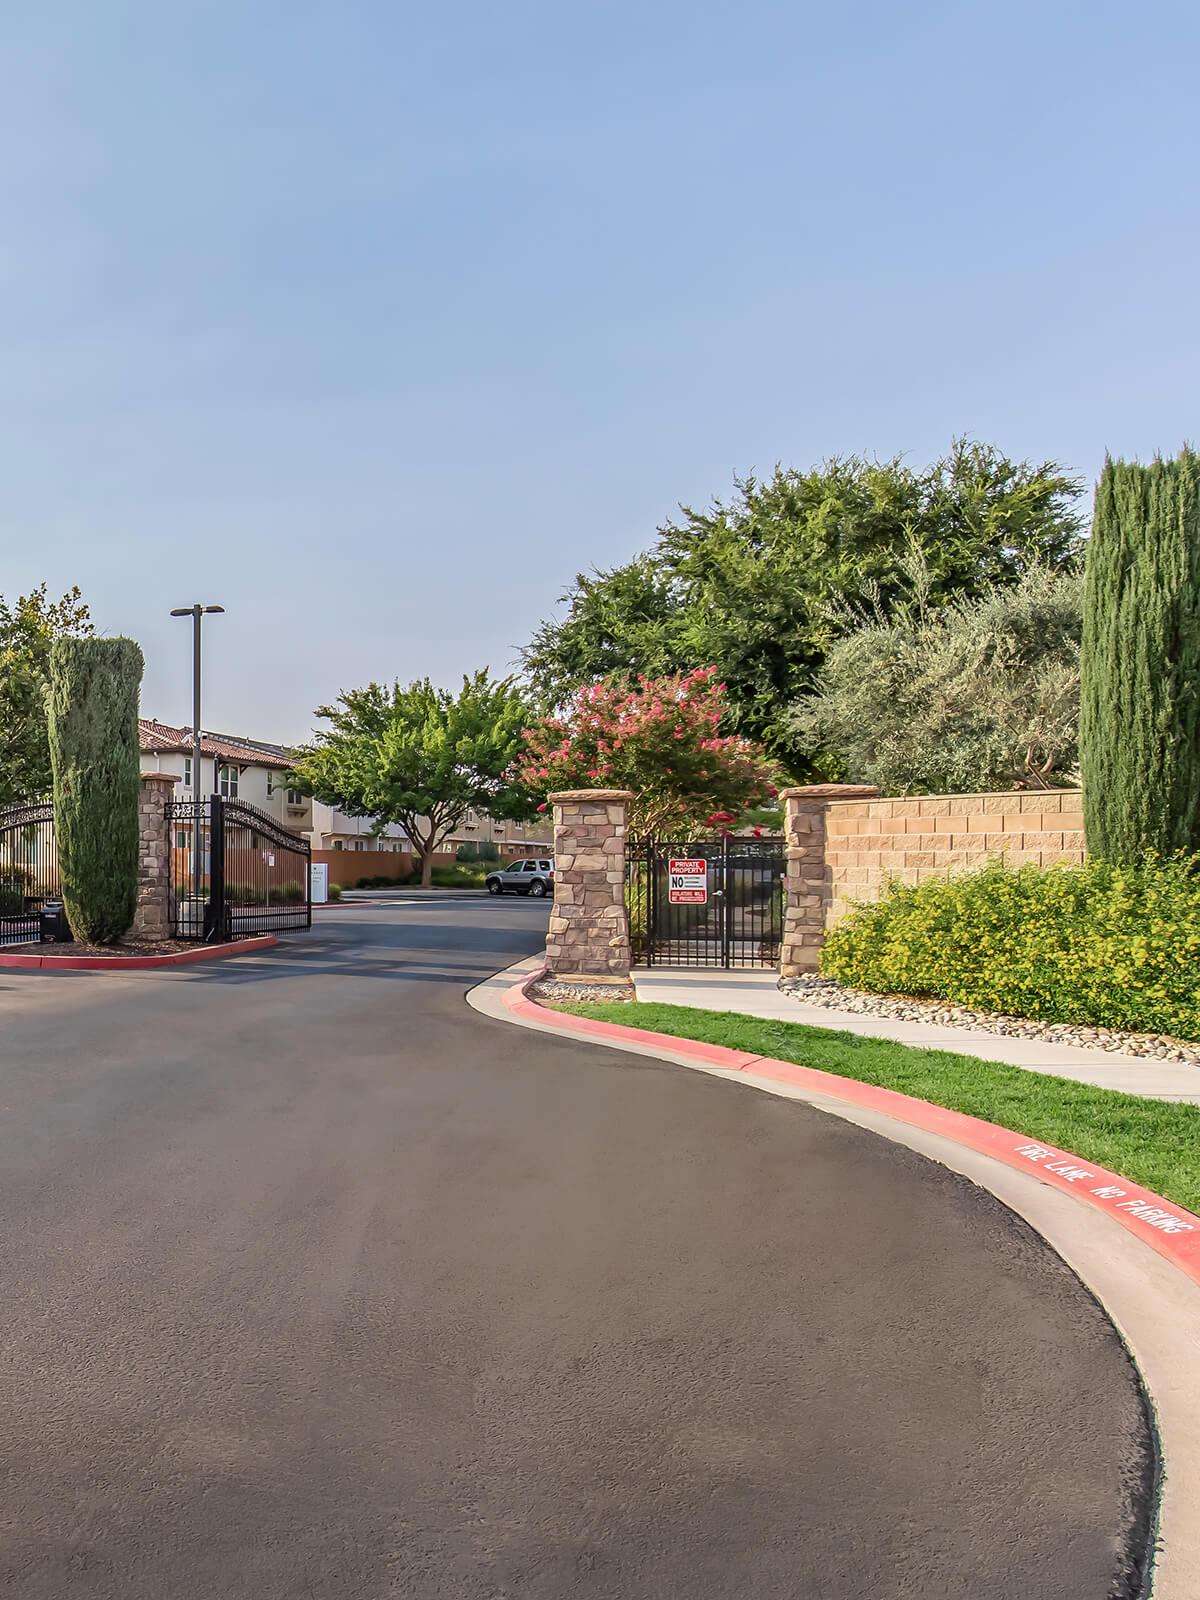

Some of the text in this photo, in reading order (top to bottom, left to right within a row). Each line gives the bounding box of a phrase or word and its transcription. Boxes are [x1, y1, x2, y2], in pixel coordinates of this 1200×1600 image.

[672, 876, 684, 888] NO
[1013, 1143, 1195, 1234] FIRE LANE NO PARKING
